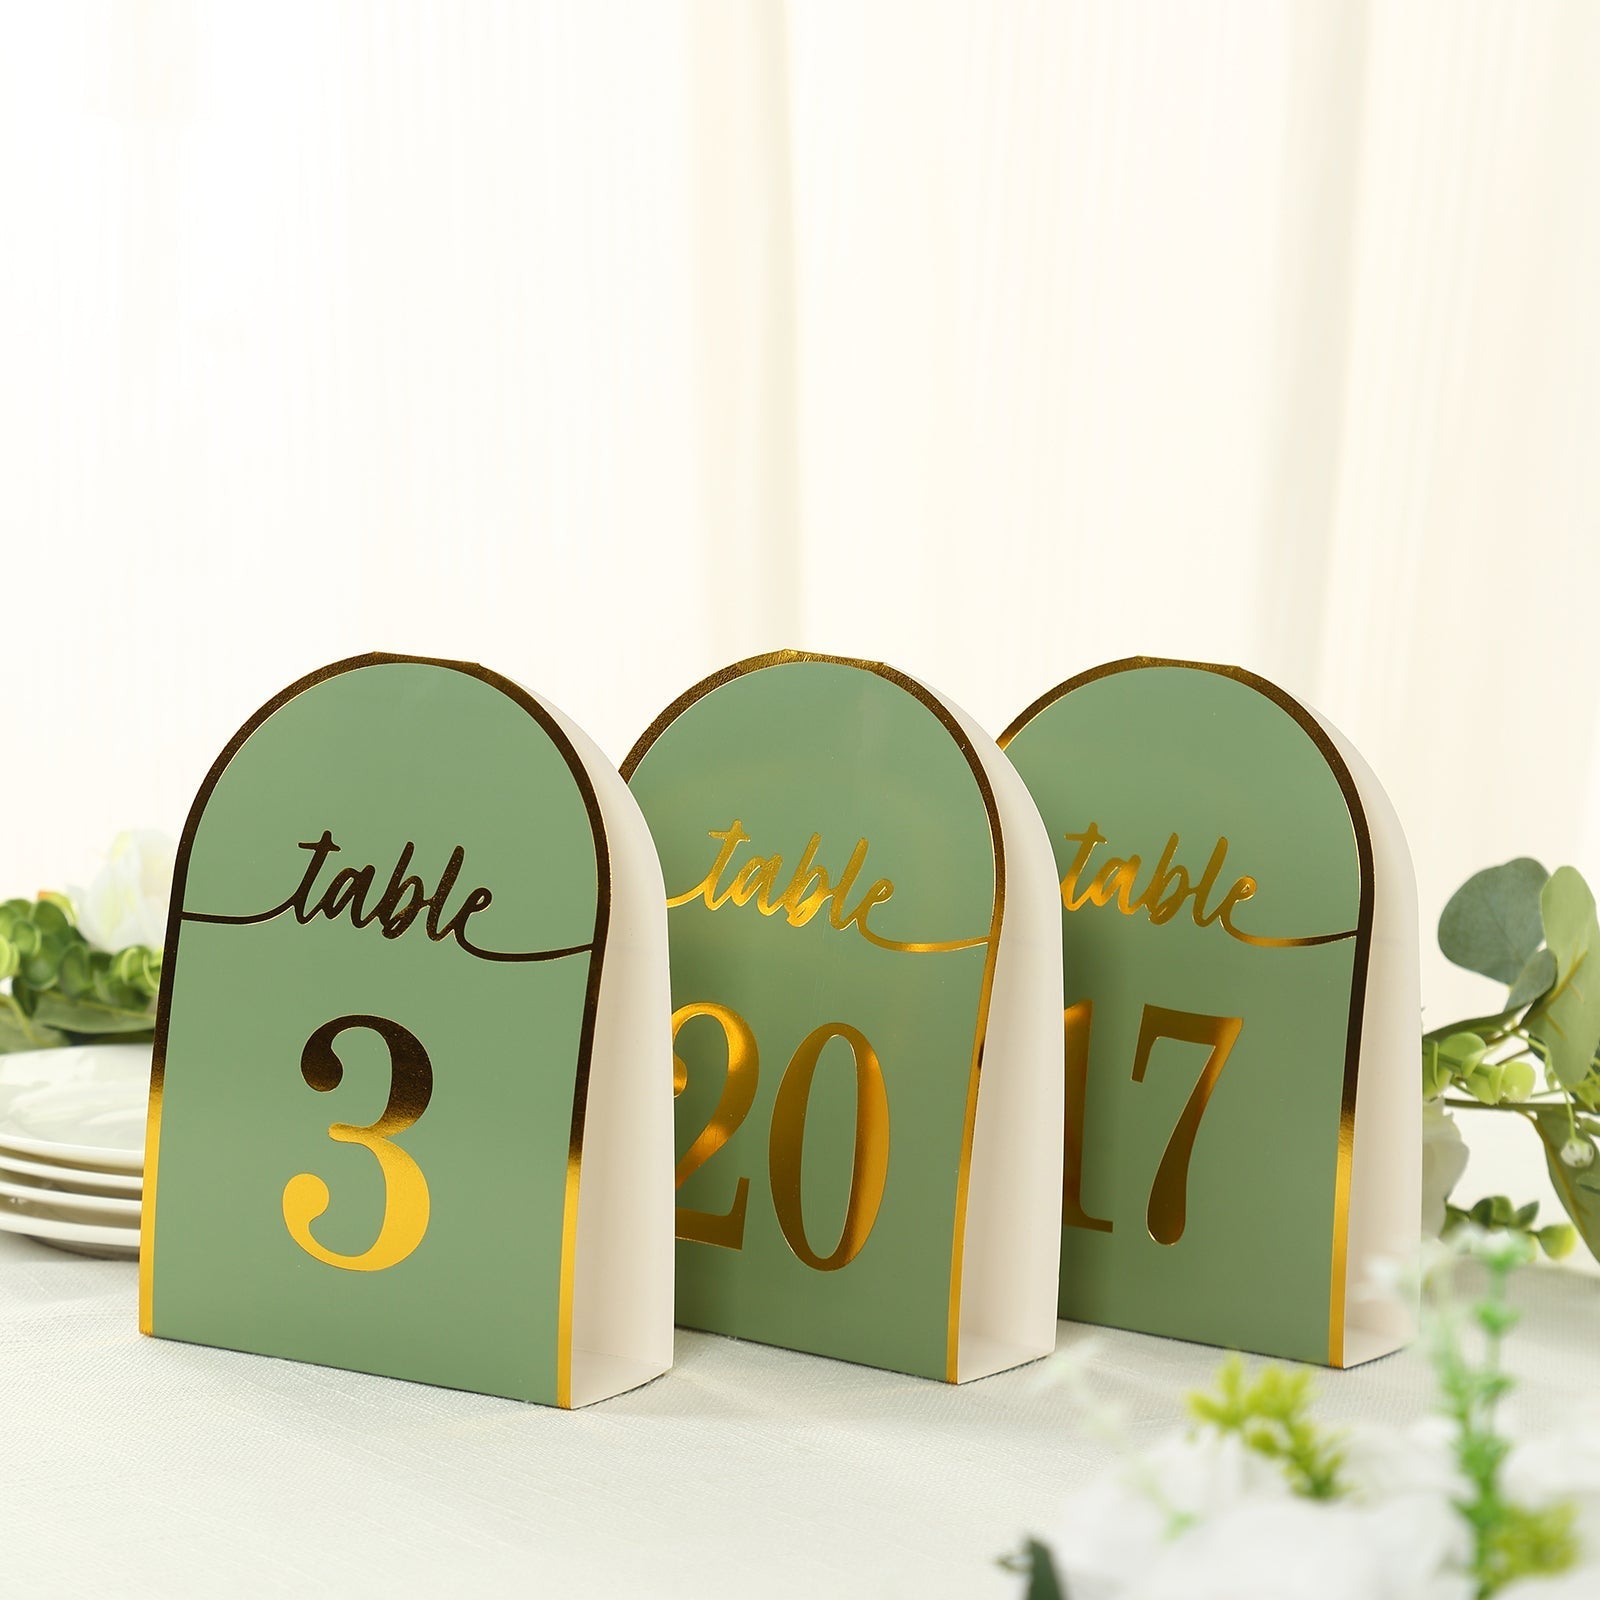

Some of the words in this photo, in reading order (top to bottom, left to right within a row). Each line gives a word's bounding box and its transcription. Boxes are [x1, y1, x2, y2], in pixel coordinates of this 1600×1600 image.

[250, 831, 525, 961] table
[690, 820, 910, 951] table
[1060, 822, 1285, 946] table
[282, 1014, 433, 1272] 3
[673, 1002, 890, 1271] 20
[1063, 999, 1243, 1245] 17
